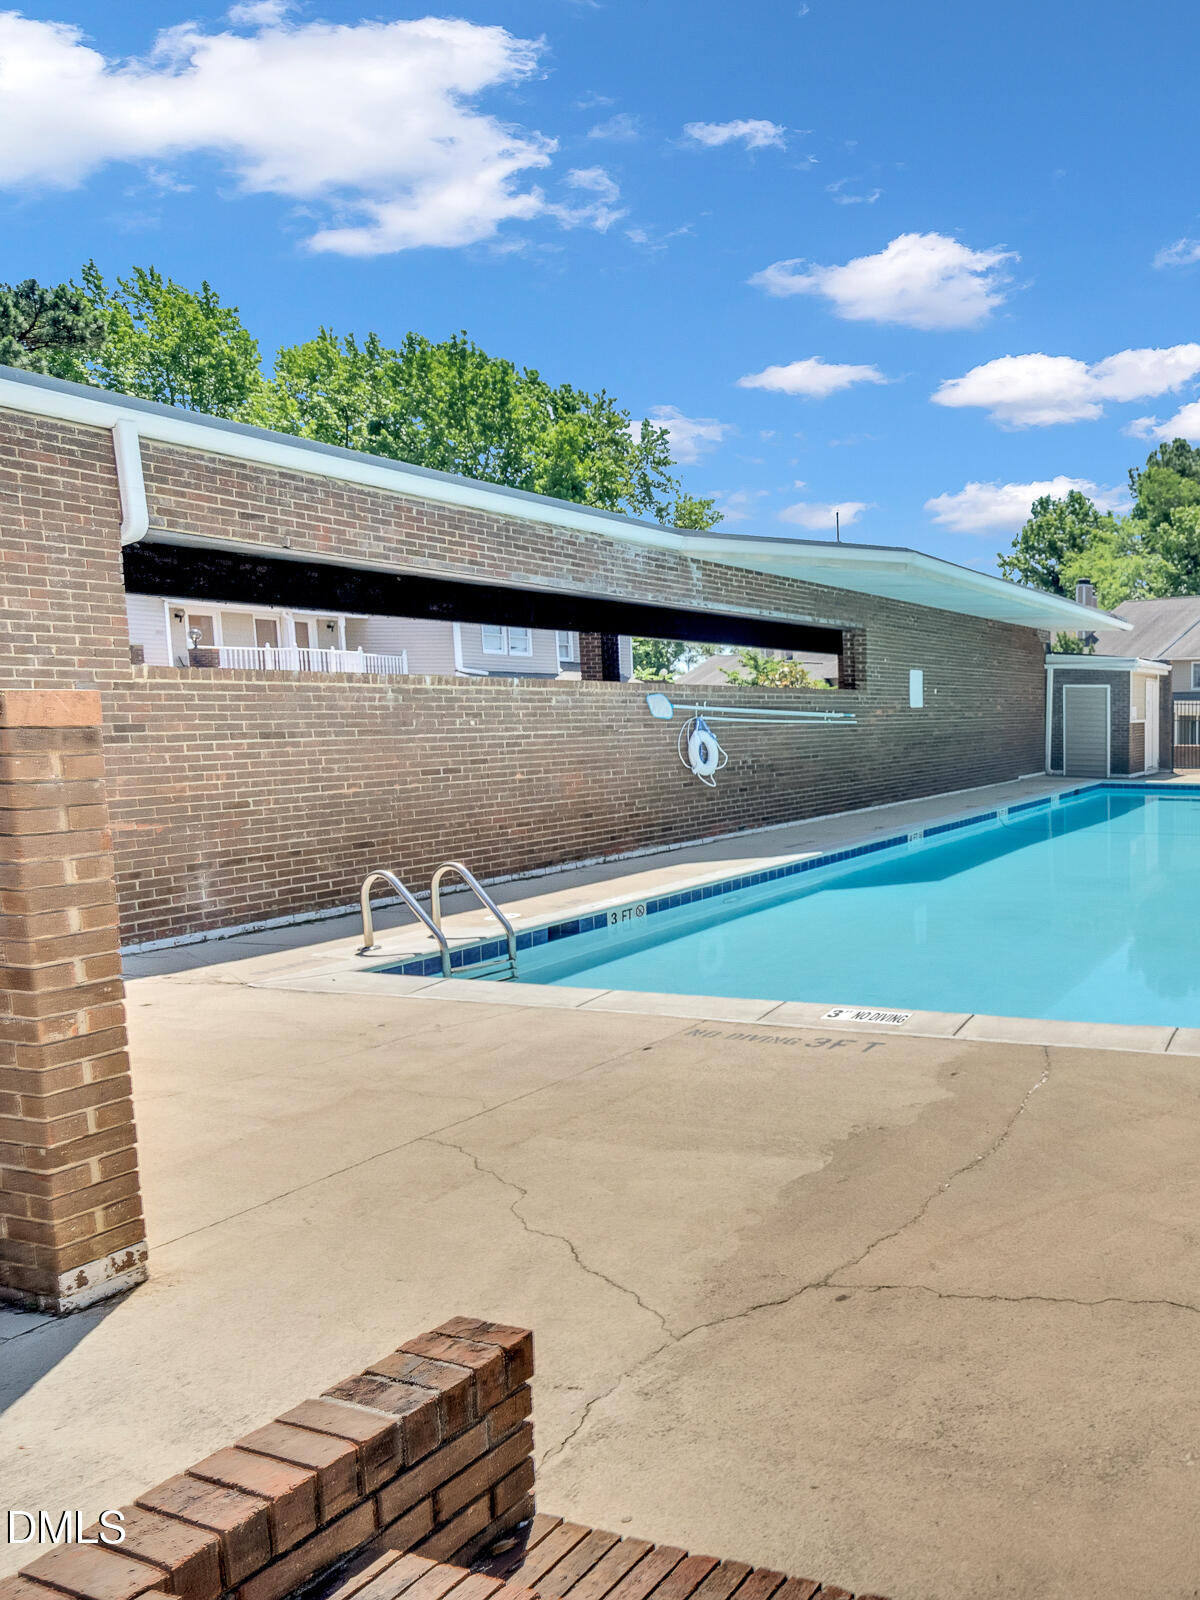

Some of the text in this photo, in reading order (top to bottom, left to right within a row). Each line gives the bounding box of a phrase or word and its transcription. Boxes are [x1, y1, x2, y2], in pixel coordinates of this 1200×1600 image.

[610, 908, 633, 925] 3 FT
[826, 1009, 844, 1018] 3
[851, 1010, 871, 1020] NO
[868, 1012, 909, 1024] DIVING
[684, 1028, 722, 1038] NO
[725, 1032, 802, 1046] DIVING
